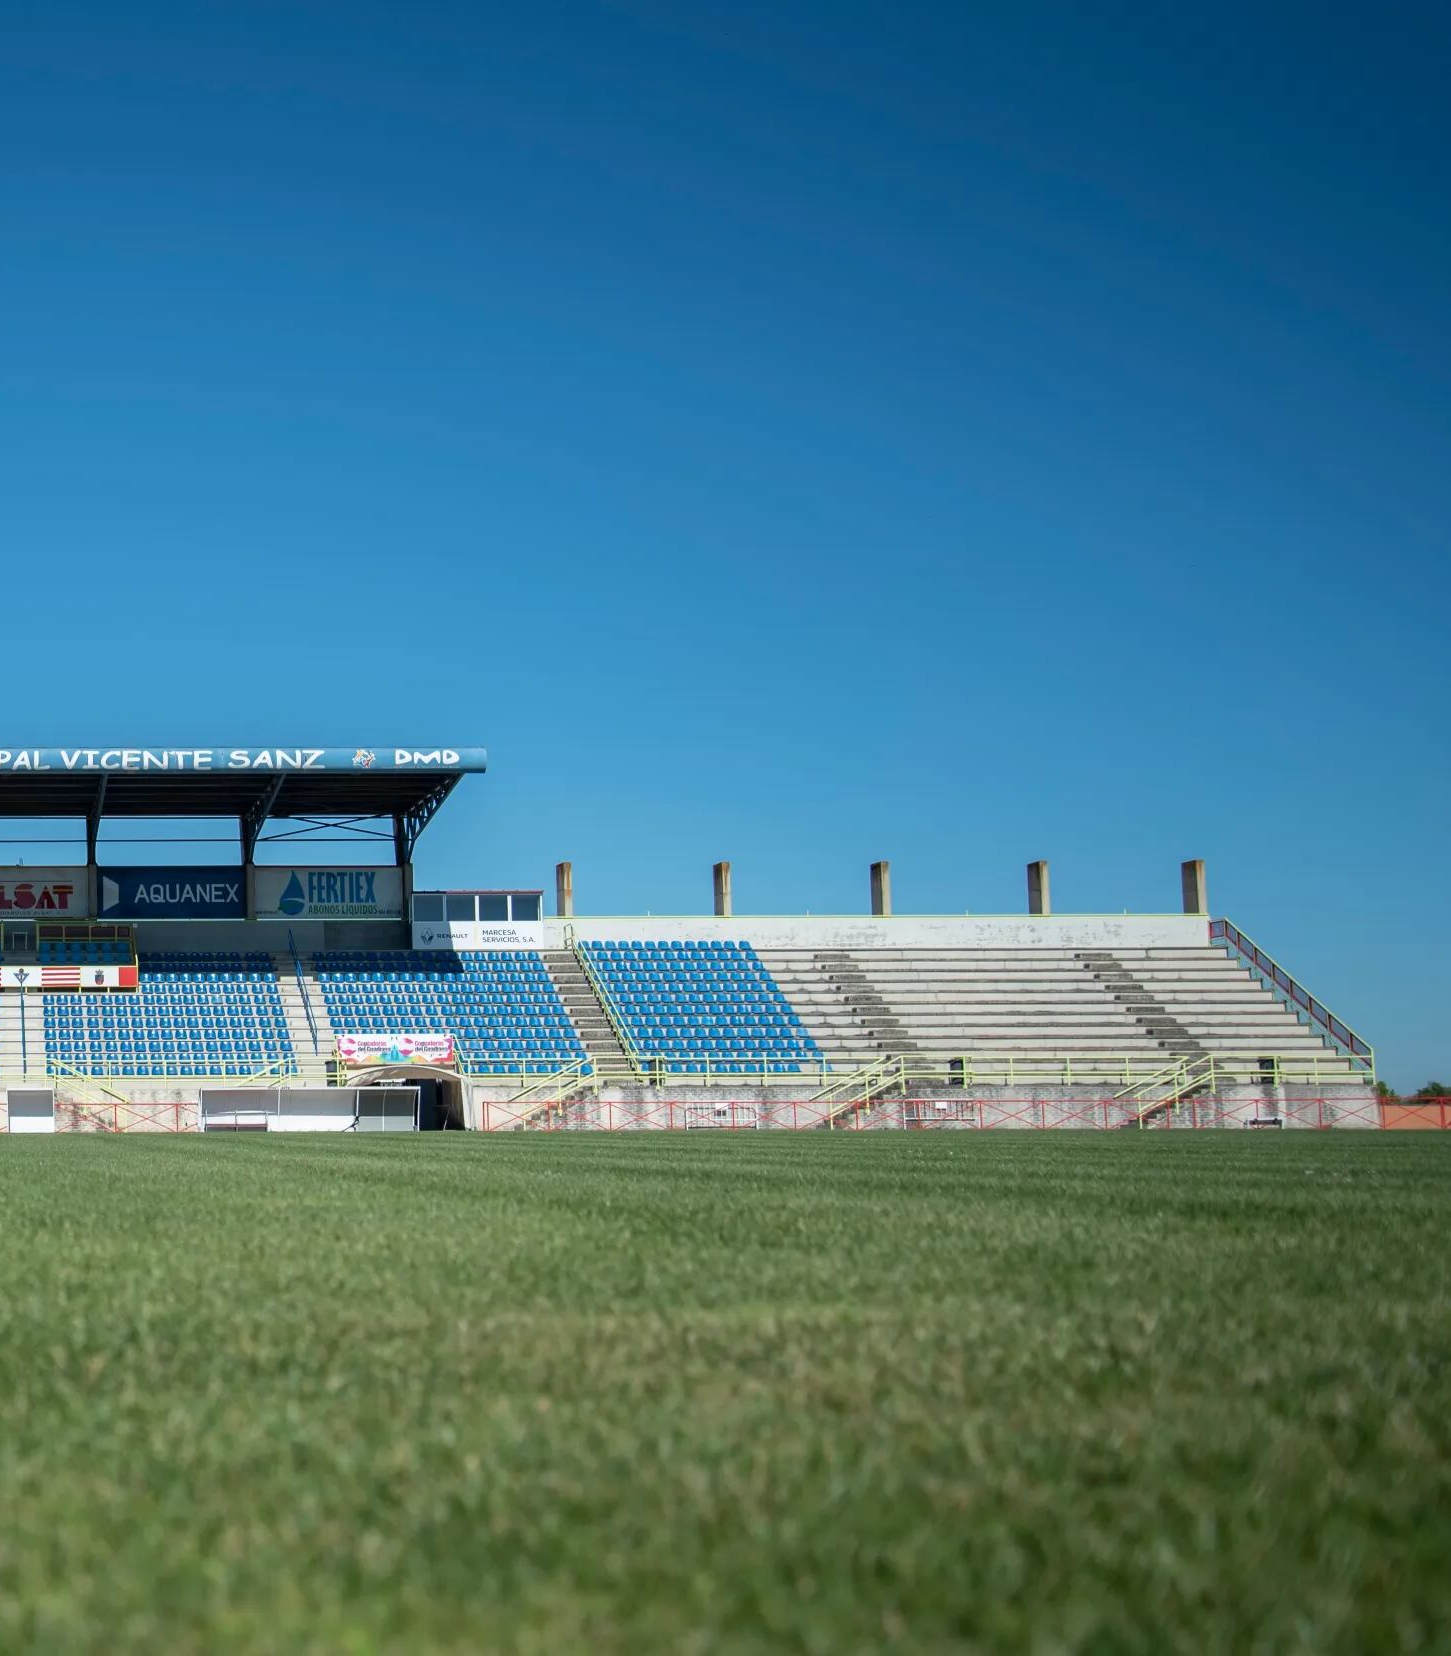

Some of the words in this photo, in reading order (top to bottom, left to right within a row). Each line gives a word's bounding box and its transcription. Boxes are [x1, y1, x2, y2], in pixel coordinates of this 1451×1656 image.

[60, 749, 214, 770] VICENTE
[227, 749, 326, 770] SANZ
[395, 749, 460, 765] DMD
[134, 883, 239, 903] AQUANEX
[308, 871, 376, 903] FERTIEX
[309, 904, 340, 915] ABONOS
